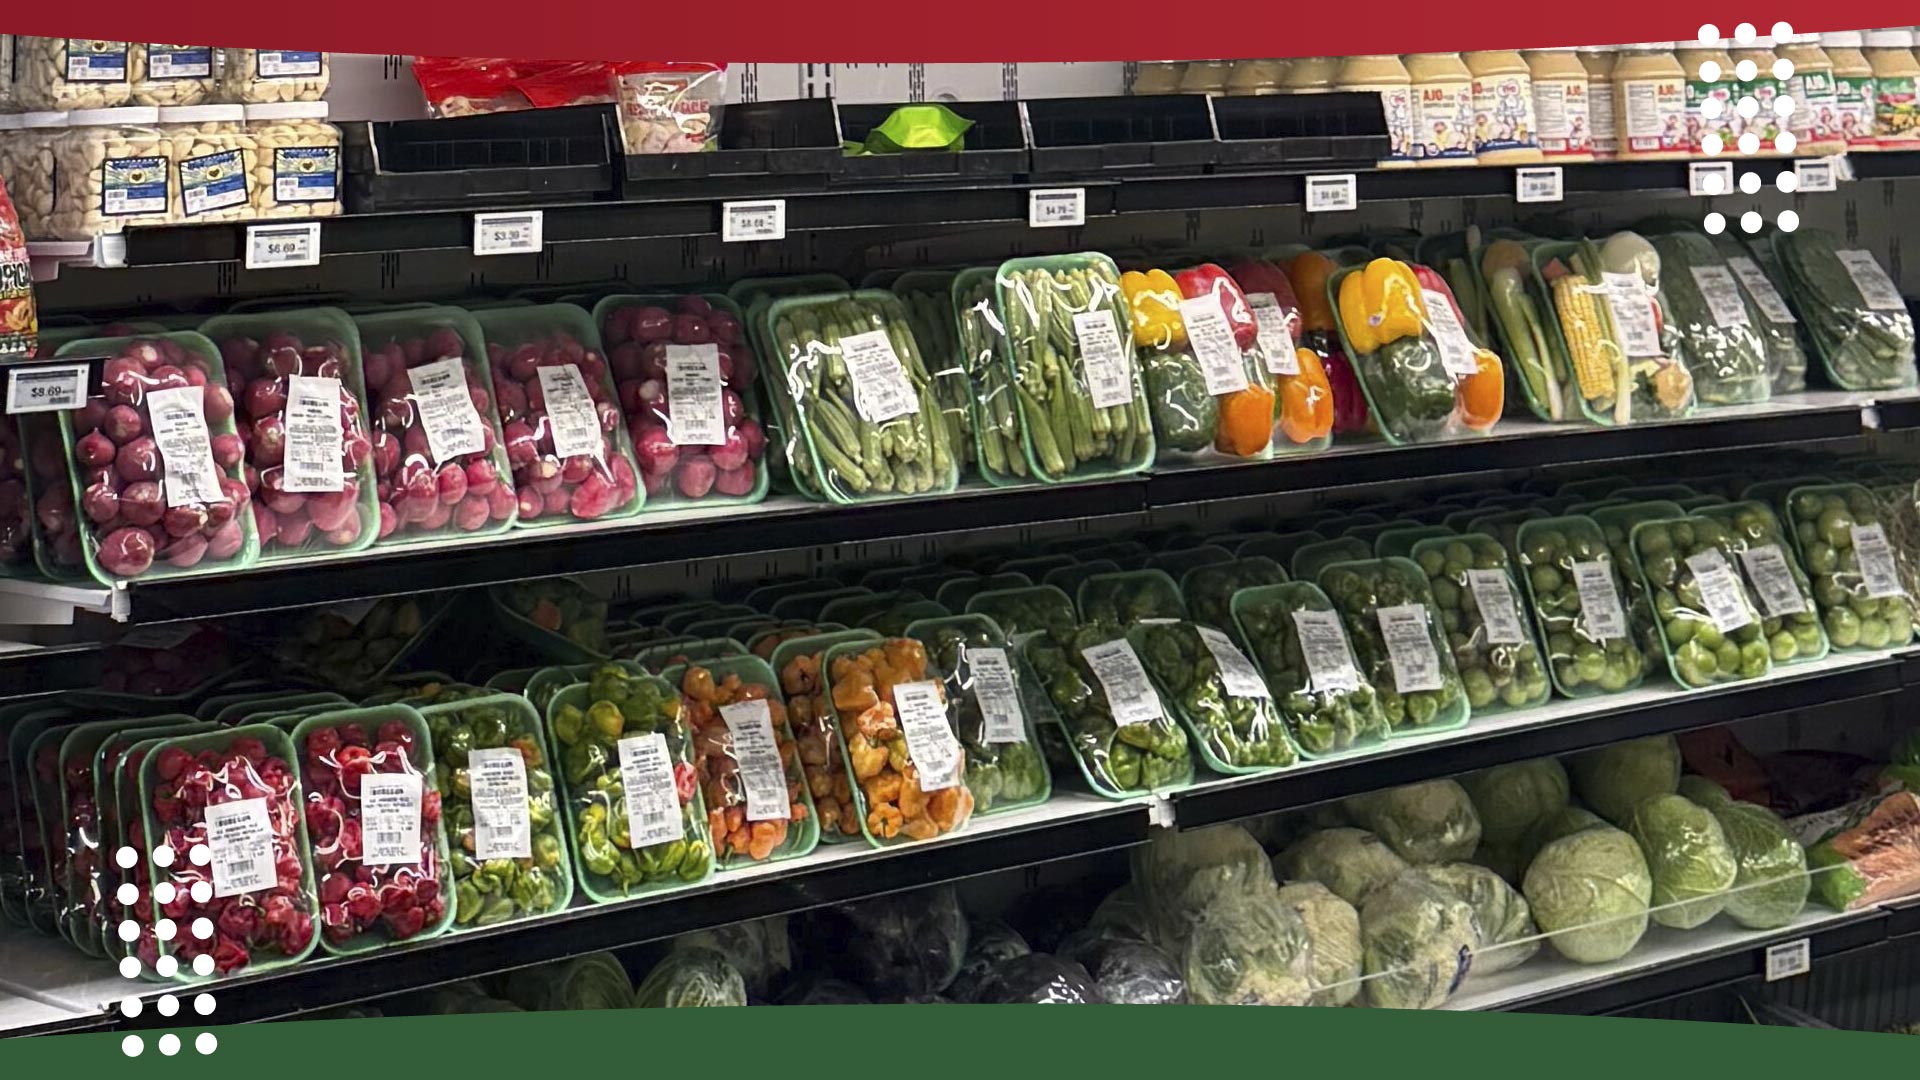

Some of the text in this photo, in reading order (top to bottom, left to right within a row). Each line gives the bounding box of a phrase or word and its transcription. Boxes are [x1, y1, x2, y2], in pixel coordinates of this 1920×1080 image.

[1423, 89, 1443, 101] AJO
[268, 243, 296, 254] $6.69
[31, 386, 62, 398] $8.69
